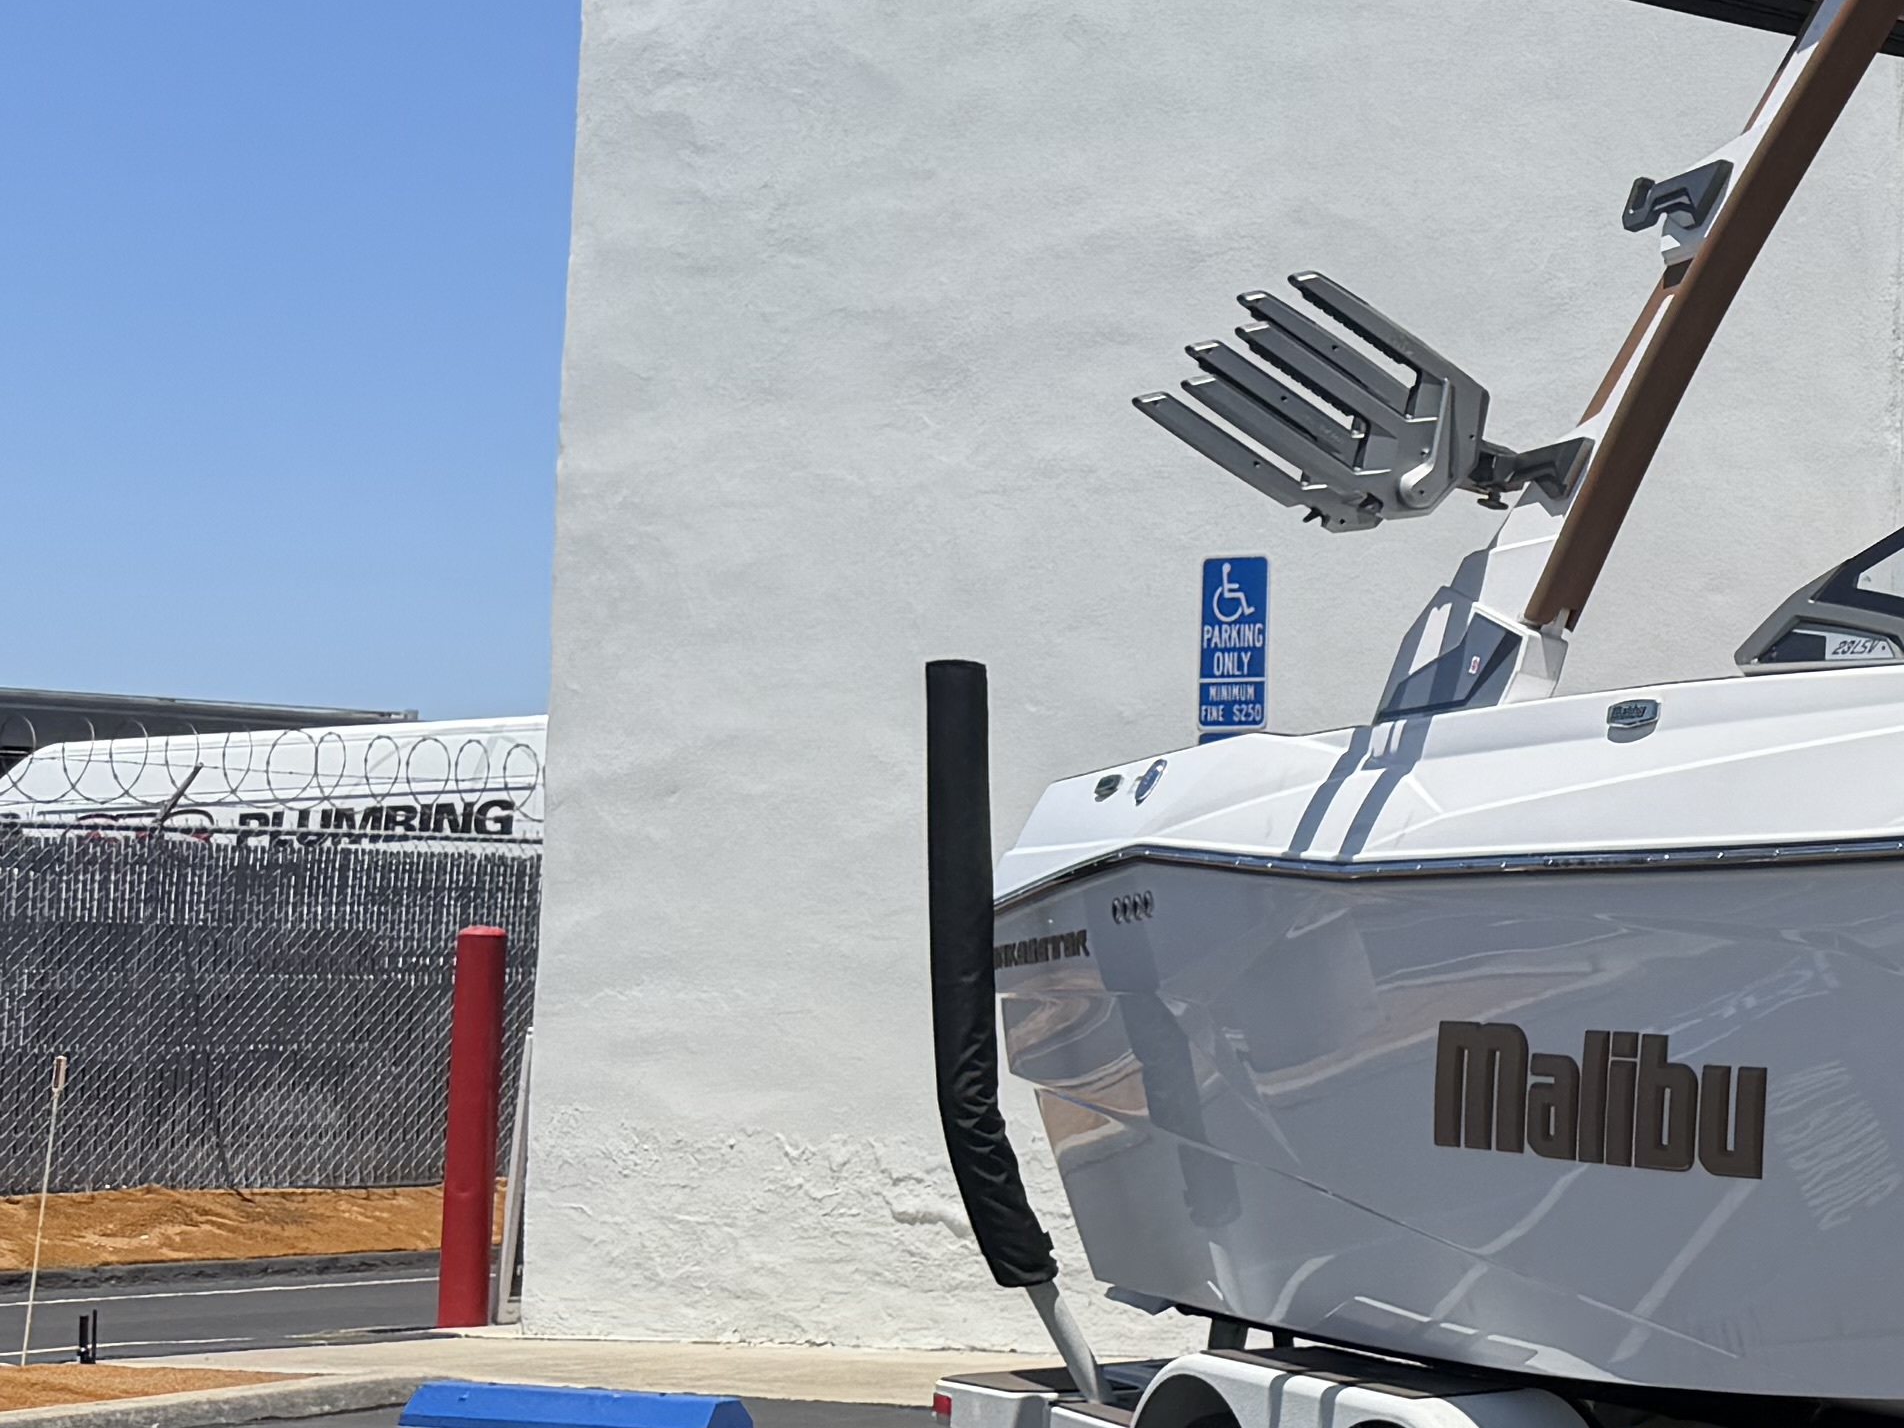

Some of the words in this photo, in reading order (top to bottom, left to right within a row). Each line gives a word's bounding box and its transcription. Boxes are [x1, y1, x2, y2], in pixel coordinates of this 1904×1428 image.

[1203, 623, 1264, 649] PARKING
[1213, 652, 1252, 676] ONLY
[1209, 684, 1255, 702] MINIMUM
[1201, 706, 1225, 722] FINE
[1232, 705, 1263, 722] $250
[235, 800, 515, 847] PLUMBING
[1433, 1020, 1768, 1181] Malibu
